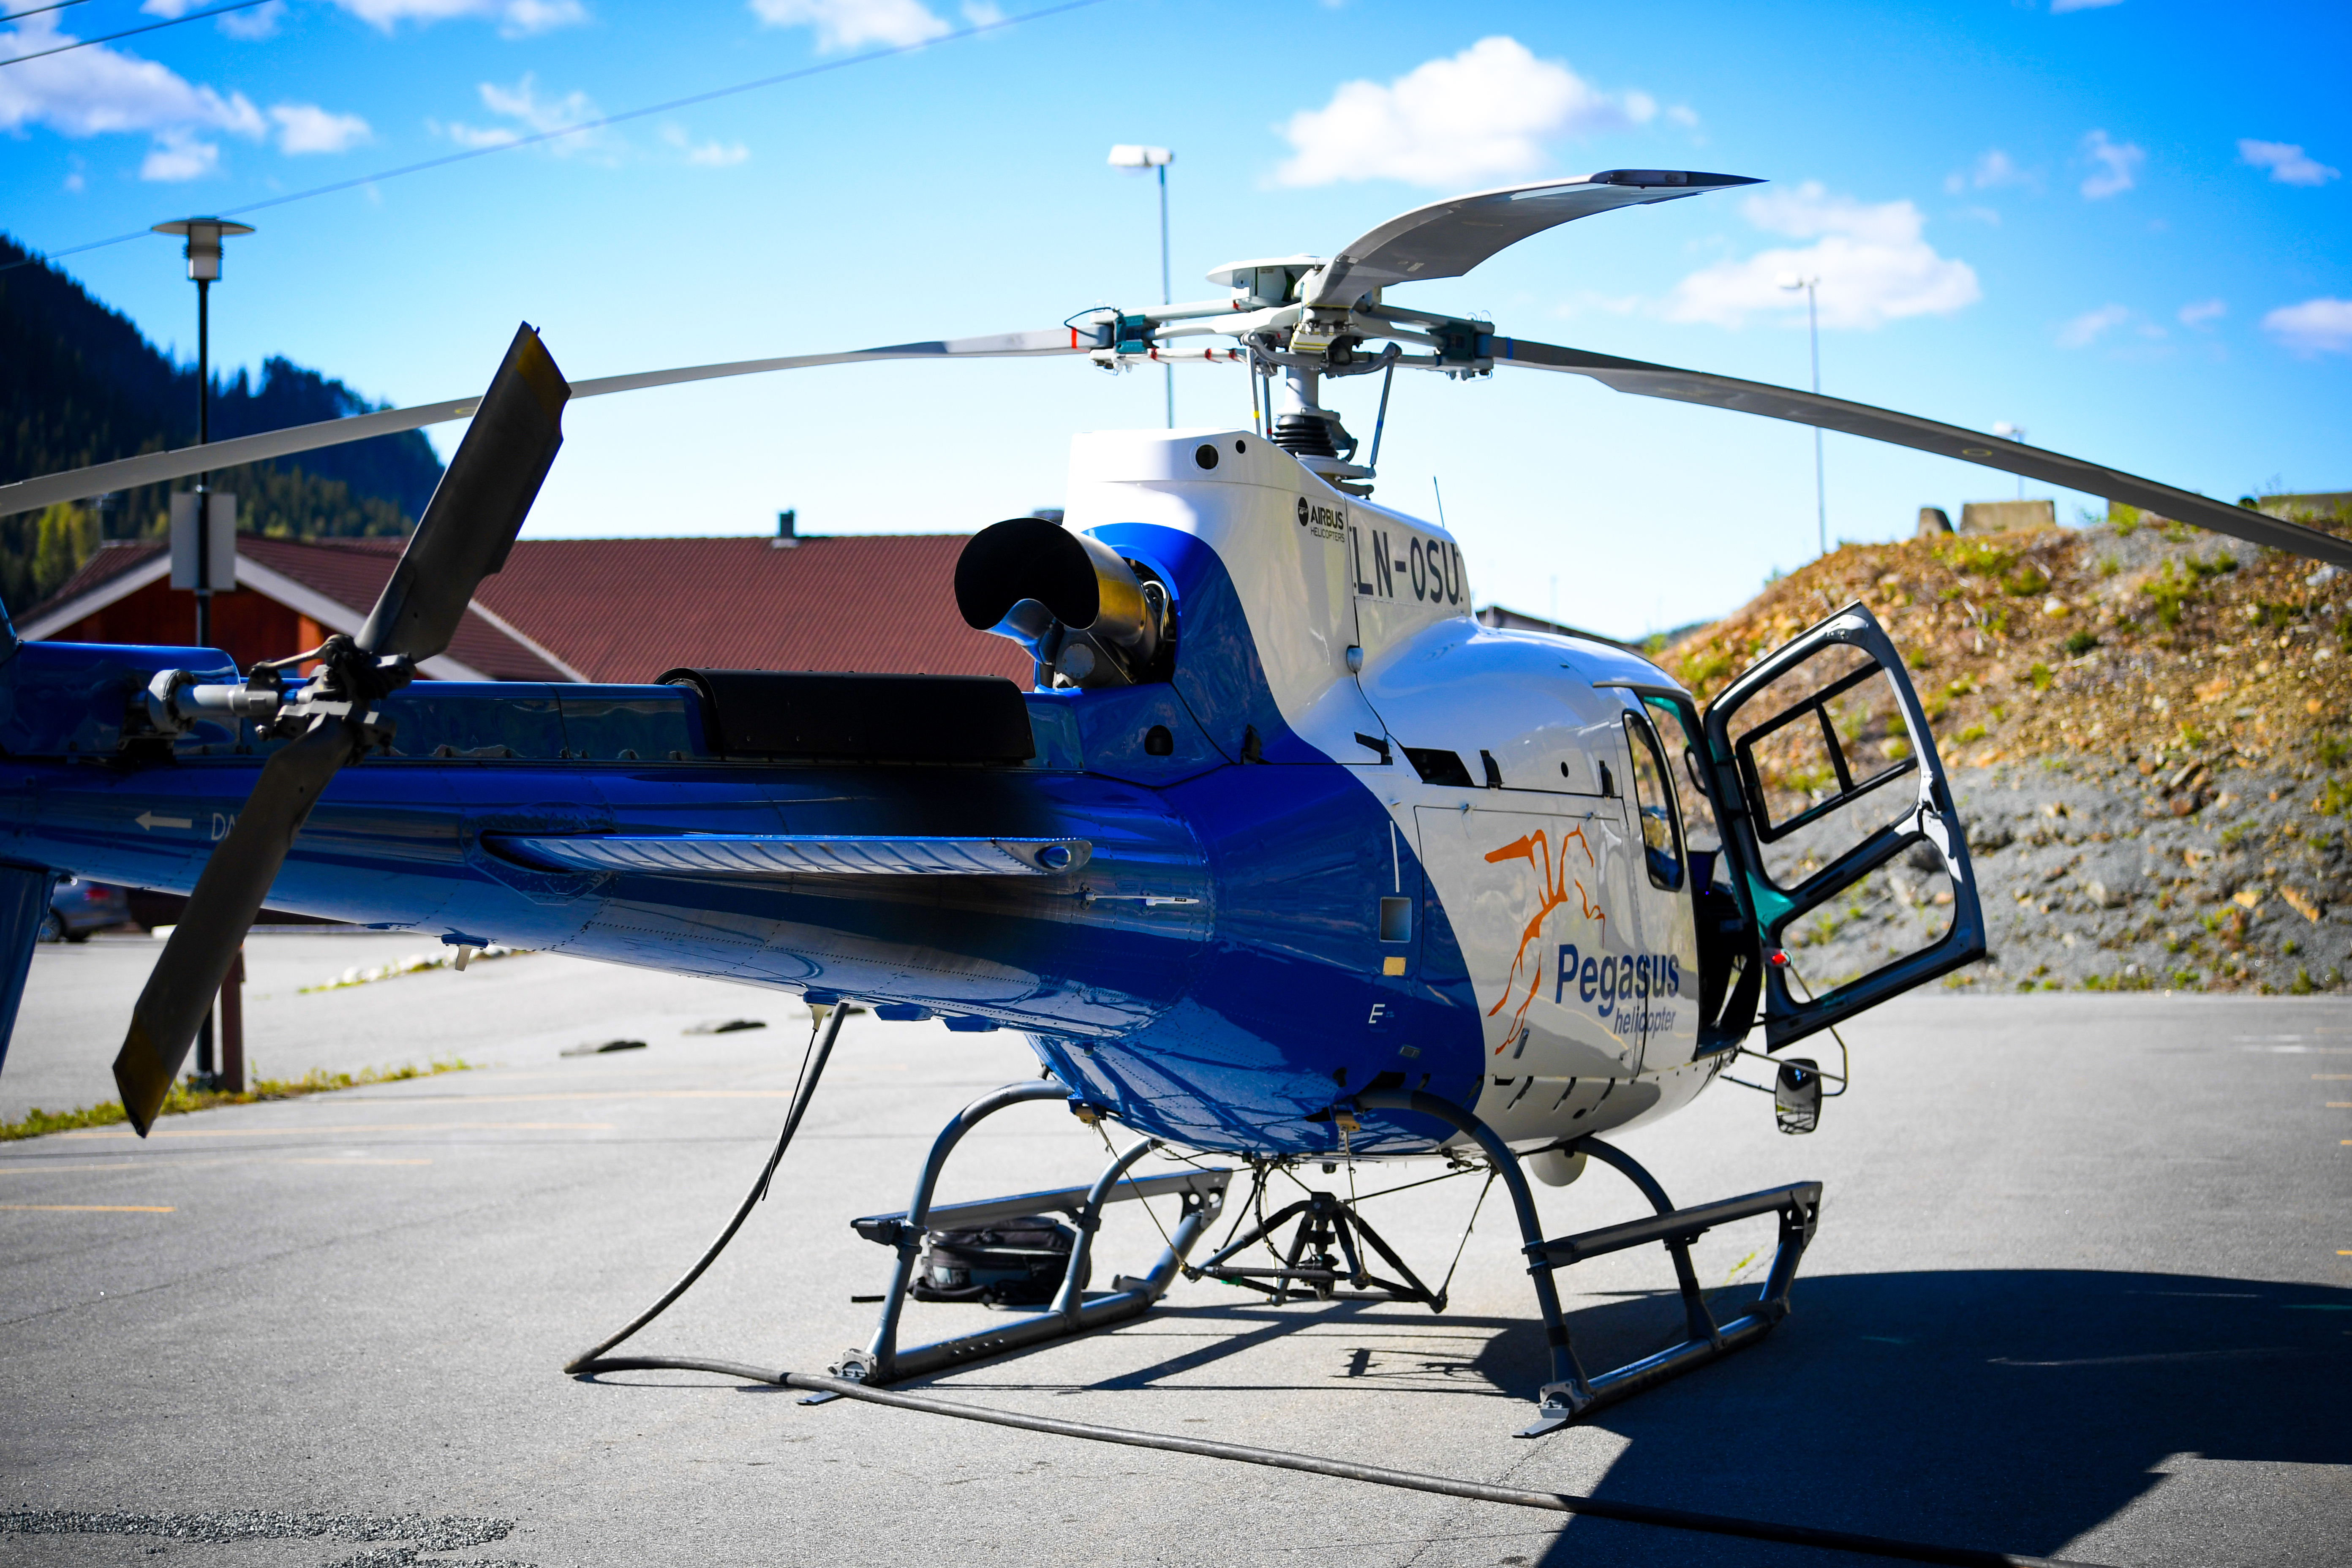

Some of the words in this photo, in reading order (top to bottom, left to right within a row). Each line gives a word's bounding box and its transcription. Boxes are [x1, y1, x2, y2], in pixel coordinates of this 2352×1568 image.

[1310, 505, 1344, 530] AIRBUS
[1310, 526, 1345, 543] HELICOPTERS
[1353, 526, 1460, 605] LN-OSU
[1555, 943, 1679, 1018] Pegasus
[1368, 1003, 1386, 1024] E
[1614, 1006, 1677, 1040] helicopter
